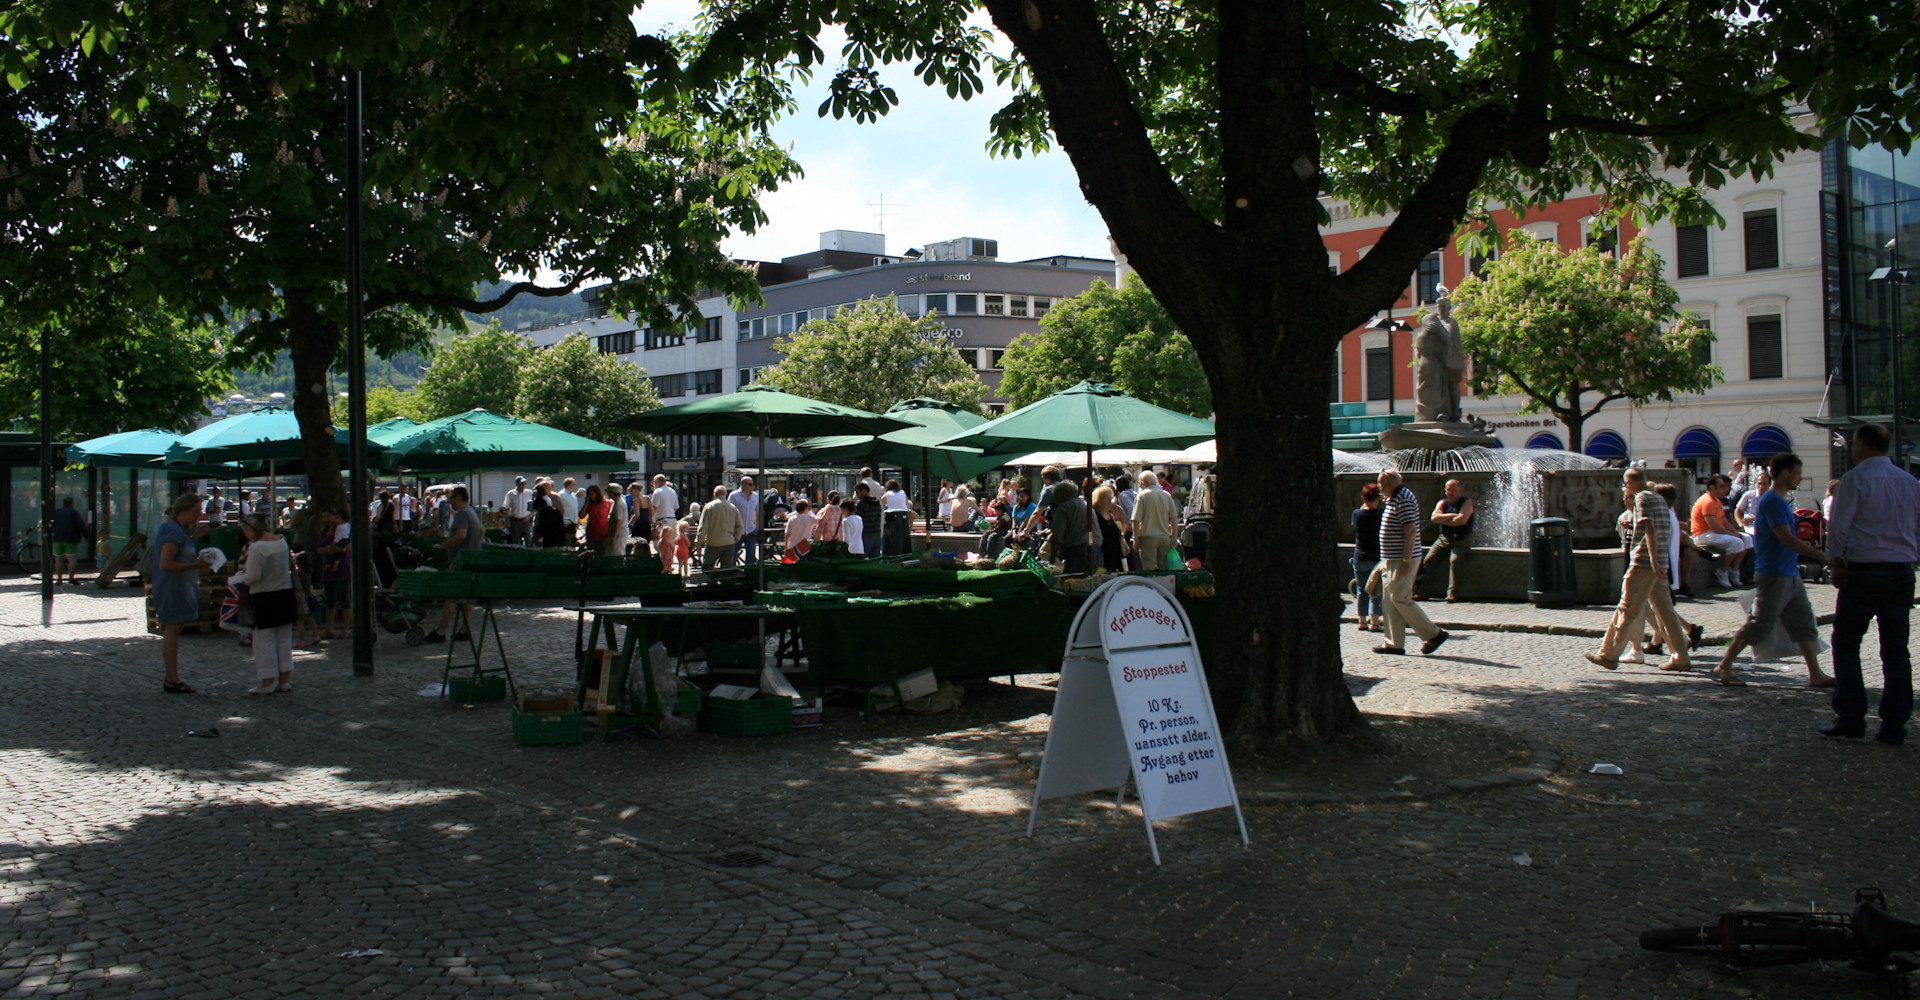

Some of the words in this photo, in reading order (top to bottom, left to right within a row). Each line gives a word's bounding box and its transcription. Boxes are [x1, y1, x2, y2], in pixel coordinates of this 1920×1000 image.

[920, 272, 971, 281] stbrand
[1487, 420, 1540, 429] Sparebanken
[1543, 418, 1557, 427] Øst
[1110, 606, 1177, 634] Tøffetoget
[1123, 661, 1188, 682] Stoppested
[1148, 699, 1160, 713] 10
[1162, 697, 1182, 713] Kr.
[1138, 719, 1158, 734] Pr.
[1160, 715, 1199, 732] person,
[1135, 734, 1180, 750] uansett
[1182, 729, 1211, 743] alder.
[1141, 752, 1186, 772] Avgang
[1188, 749, 1214, 761] etter
[1166, 770, 1199, 784] behov
